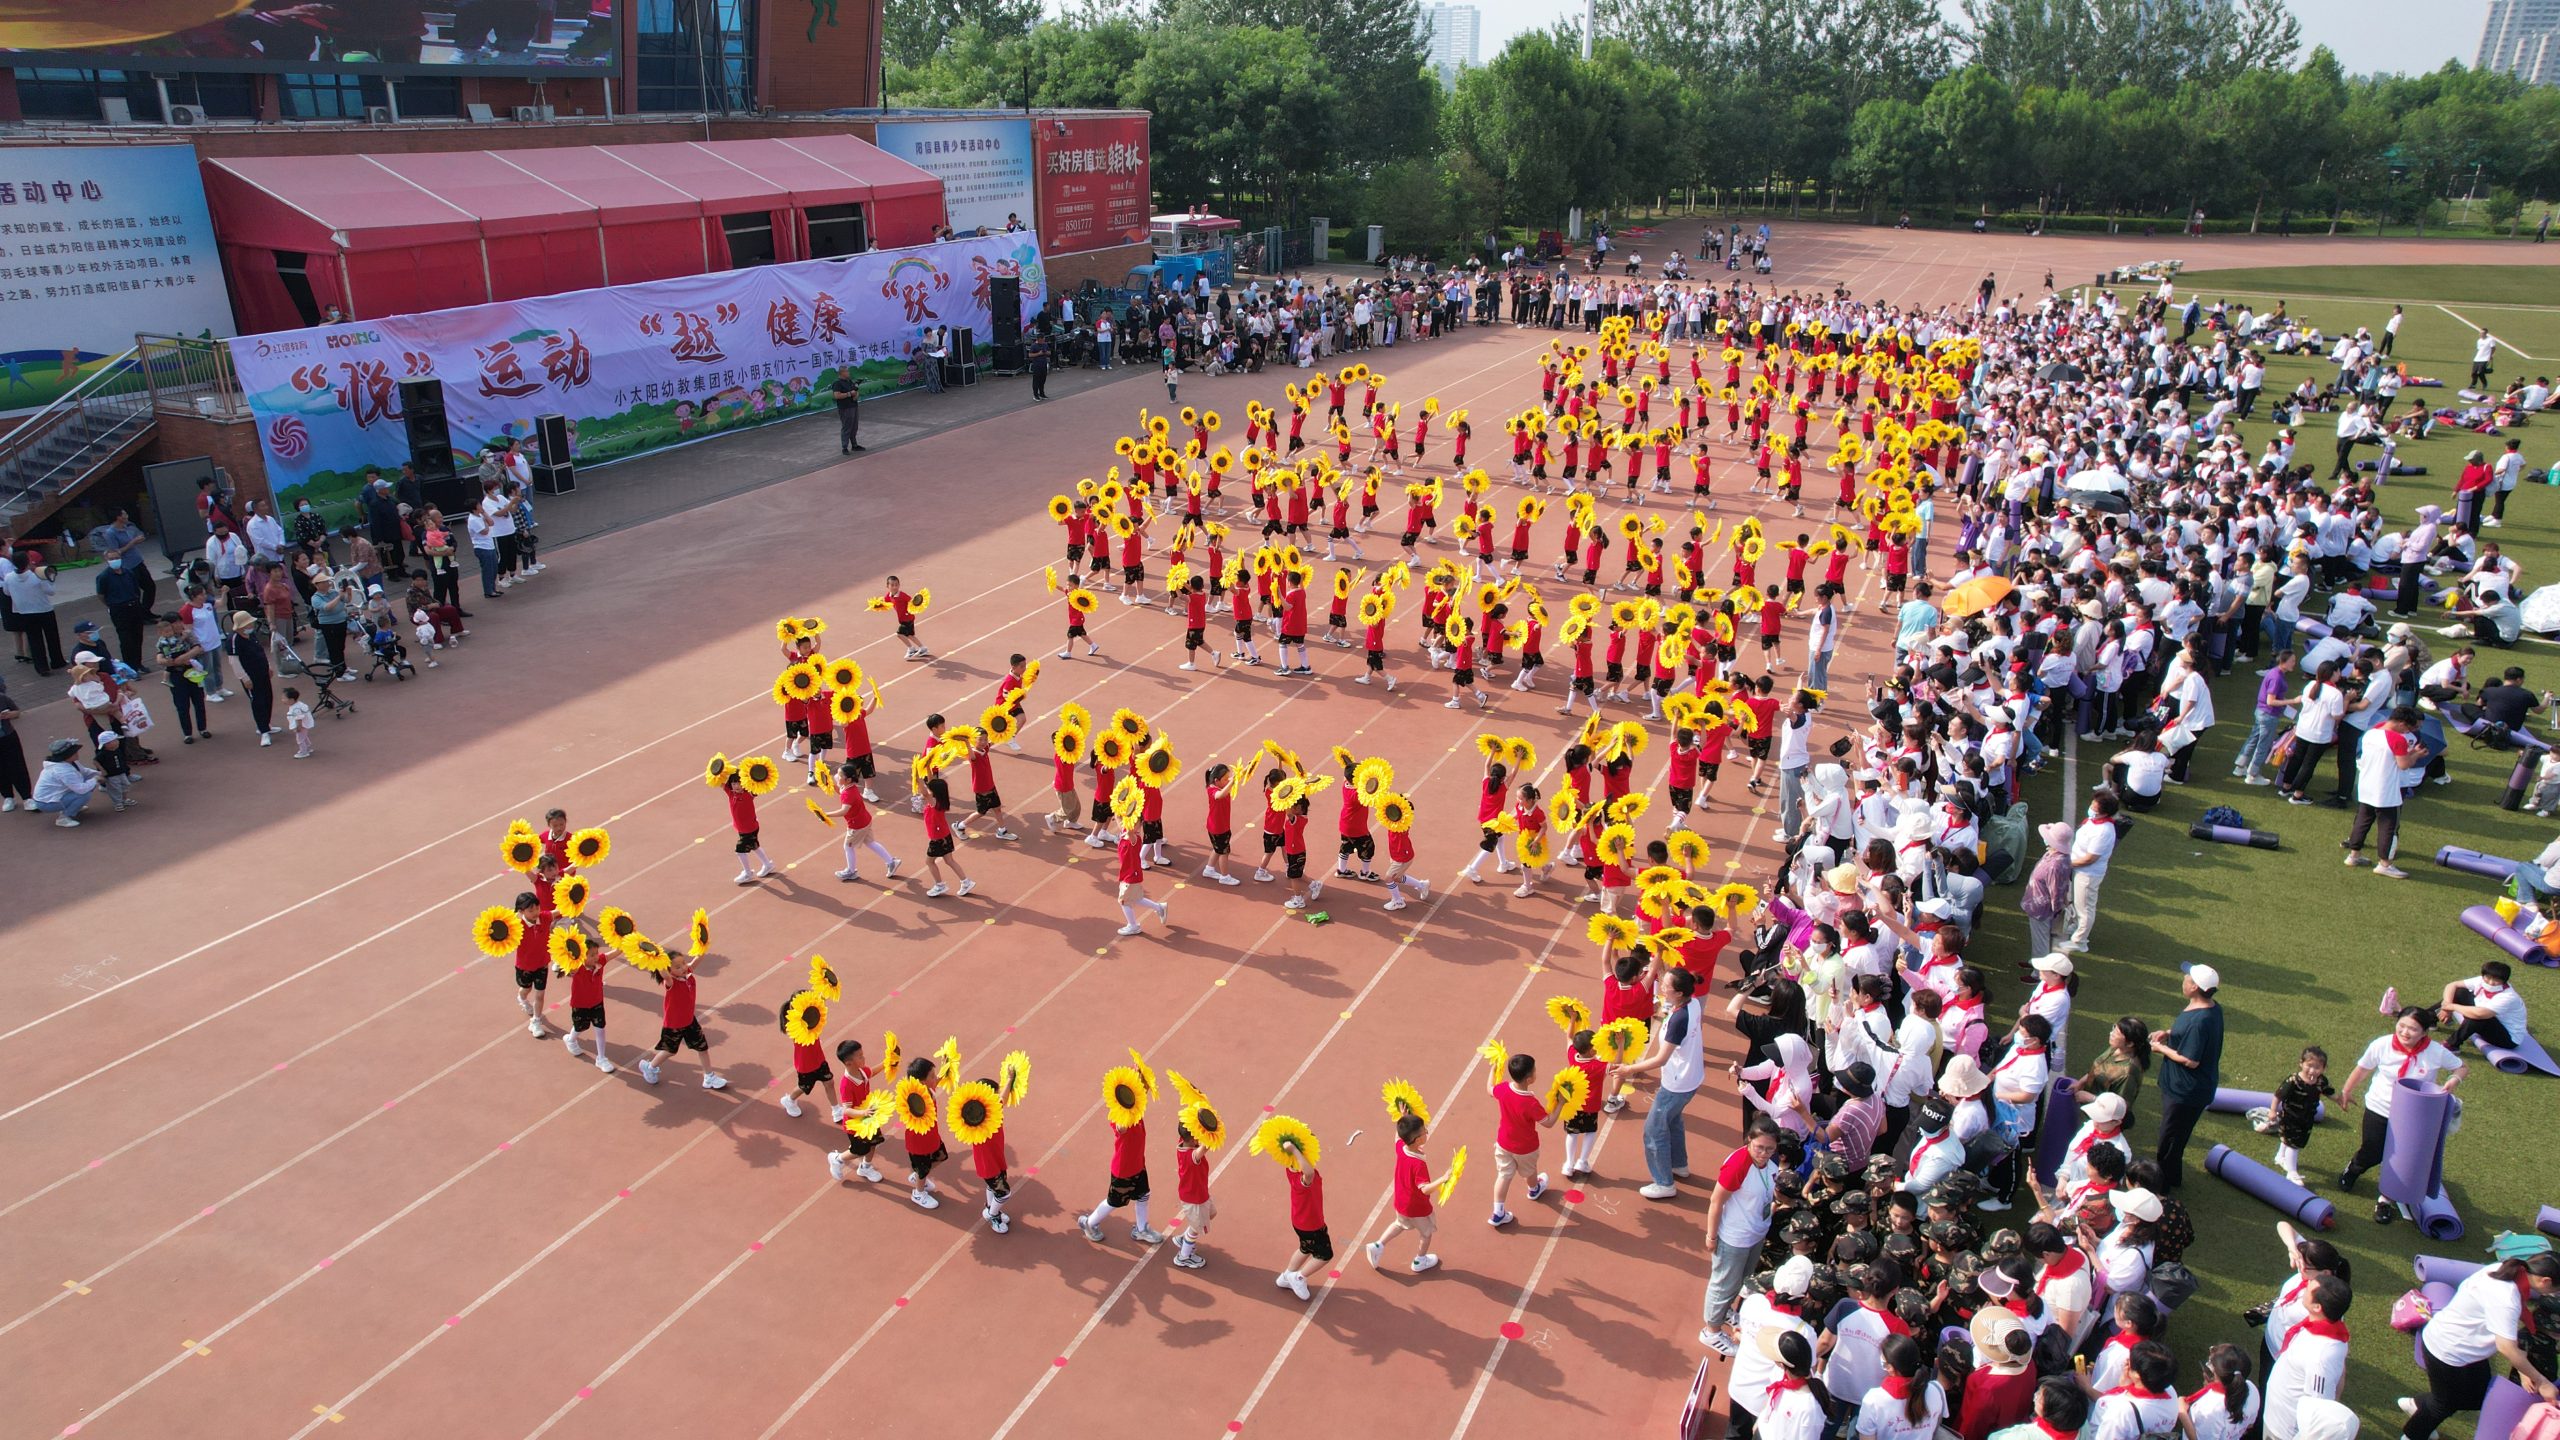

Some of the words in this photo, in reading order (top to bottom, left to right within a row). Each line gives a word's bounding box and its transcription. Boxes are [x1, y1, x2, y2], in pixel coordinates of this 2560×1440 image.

[915, 138, 1001, 155] 阳信县青少年活动中心
[473, 327, 592, 400] 运动
[766, 290, 848, 348] 健康
[614, 339, 896, 407] 小太阳幼教集团祝小朋友们六一国际儿童节快乐！
